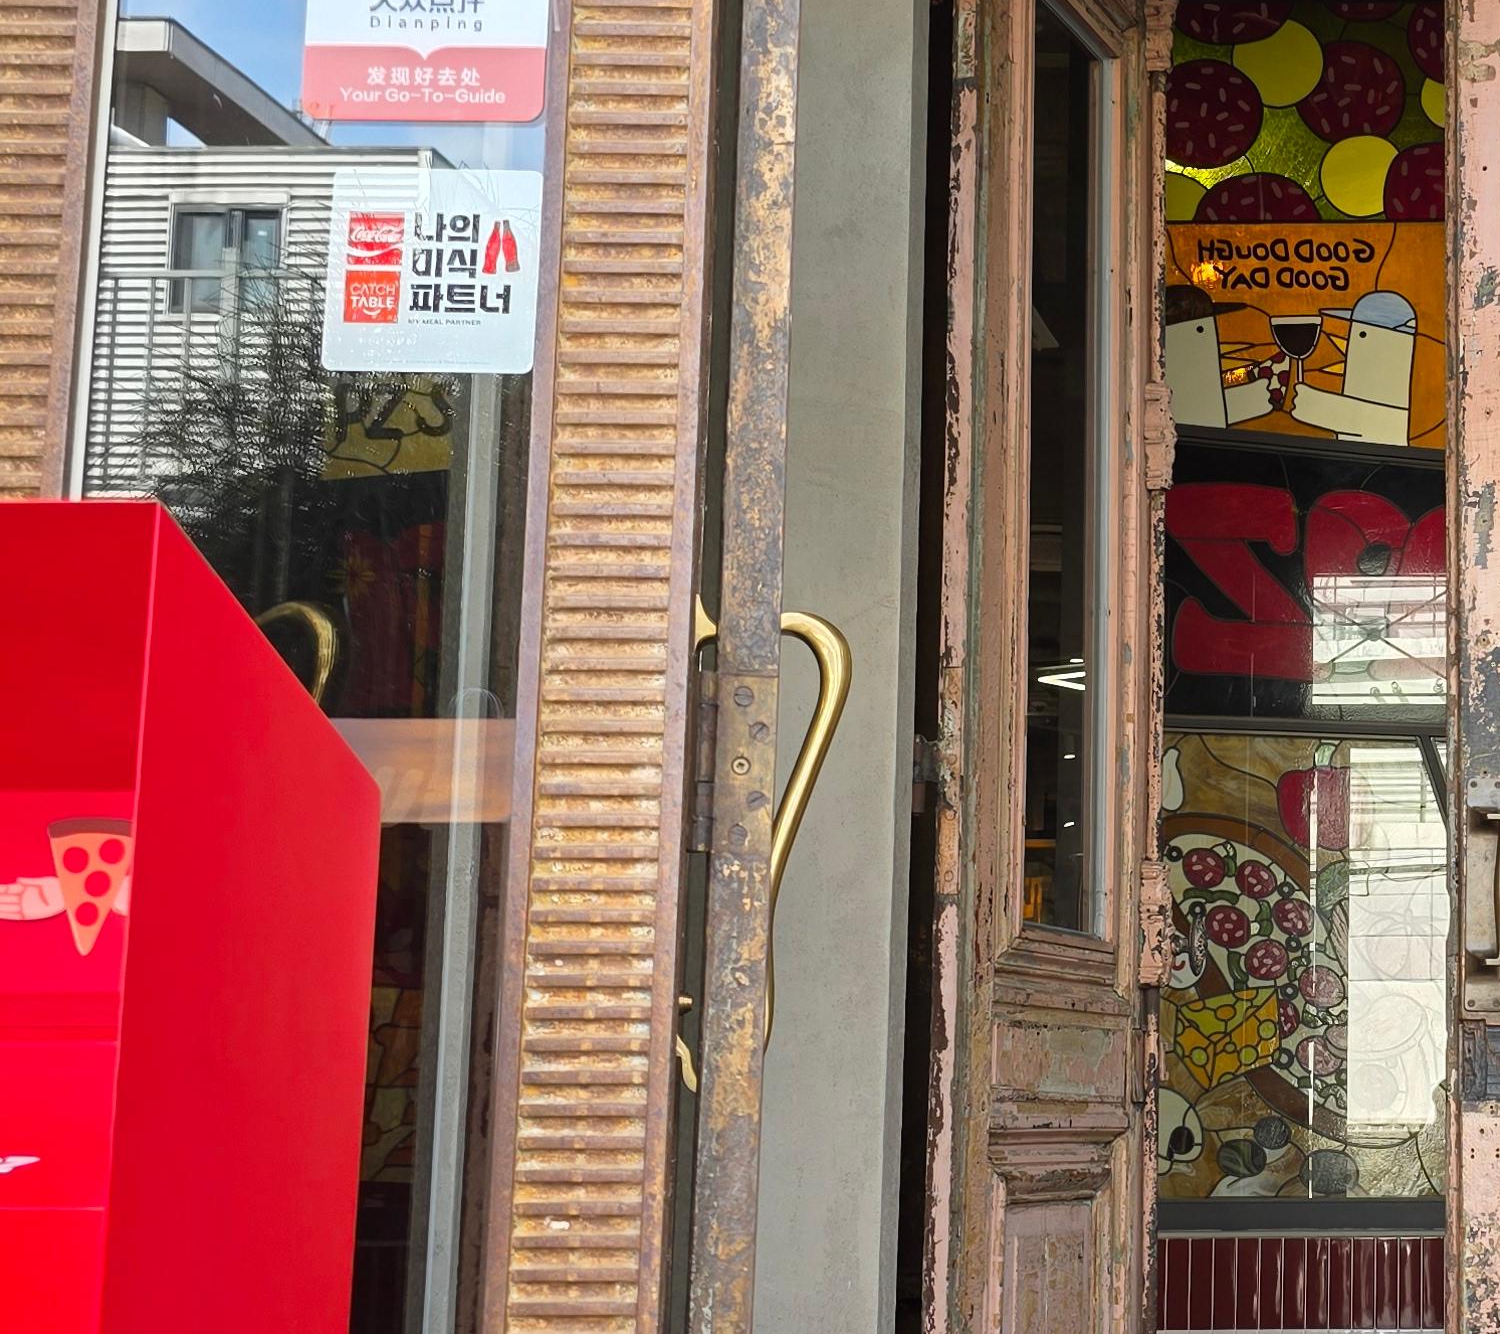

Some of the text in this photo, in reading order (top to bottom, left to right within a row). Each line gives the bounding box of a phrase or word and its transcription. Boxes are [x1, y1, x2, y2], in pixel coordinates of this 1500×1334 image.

[369, 15, 483, 32] Dianping
[366, 67, 481, 87] 发现好去处
[339, 87, 506, 104] Your Go-To-Guide
[414, 211, 480, 244] 나의
[411, 248, 478, 279] 미식
[351, 282, 396, 296] CATCH
[351, 296, 396, 309] TABLE
[408, 283, 512, 314] 파트너
